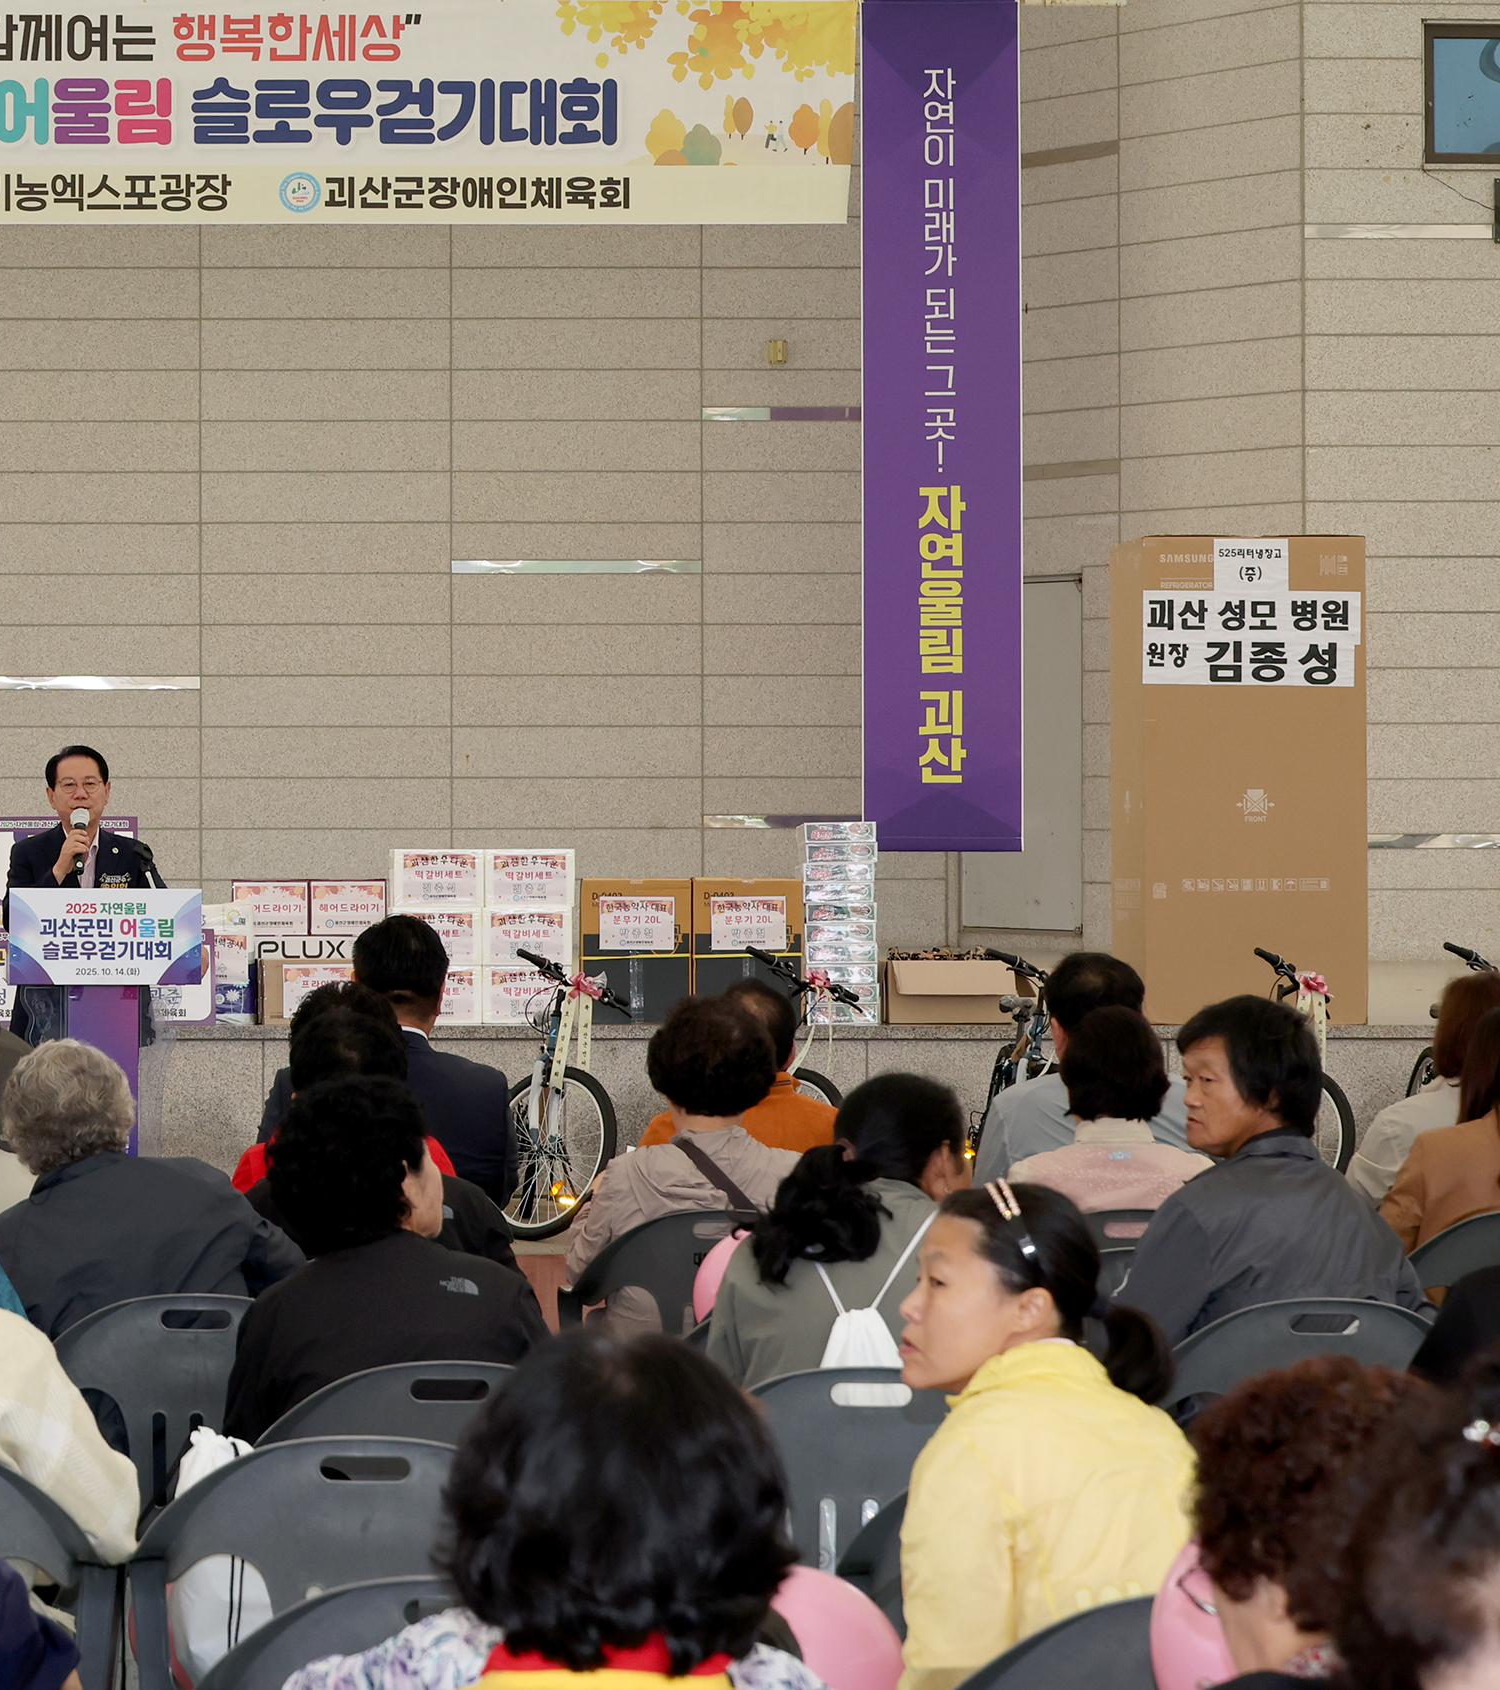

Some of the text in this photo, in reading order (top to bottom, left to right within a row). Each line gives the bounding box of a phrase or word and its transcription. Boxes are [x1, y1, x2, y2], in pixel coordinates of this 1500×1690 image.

[191, 77, 618, 146] 슬로우걷기대회
[324, 177, 630, 210] 괴산군장애인체육회
[918, 68, 967, 783] 자연이 미래가 되는 그 곳! 자연울림 괴산
[1159, 553, 1214, 563] SAMSUNG
[1218, 548, 1282, 559] 525리터냉장고
[1147, 599, 1350, 631] 괴산 성모 병원
[1146, 641, 1338, 685] 원장 김종성
[415, 870, 463, 880] 떡갈비세트
[505, 871, 554, 881] 떡갈비세트
[66, 902, 147, 915] 2025 자연울림
[319, 903, 379, 912] 헤어드라이기
[606, 901, 667, 913] 한국농약사 대표
[717, 901, 779, 913] 한국농약사 대표
[613, 915, 661, 925] 분무기 20L
[725, 915, 773, 925] 분무기 20L
[40, 918, 174, 938] 괴산군민 어울림
[502, 929, 551, 939] 떡갈비세트
[42, 941, 172, 961] 슬로우걷기대회
[257, 940, 346, 959] PLUX
[75, 967, 99, 977] 2025.
[102, 967, 113, 976] 10.
